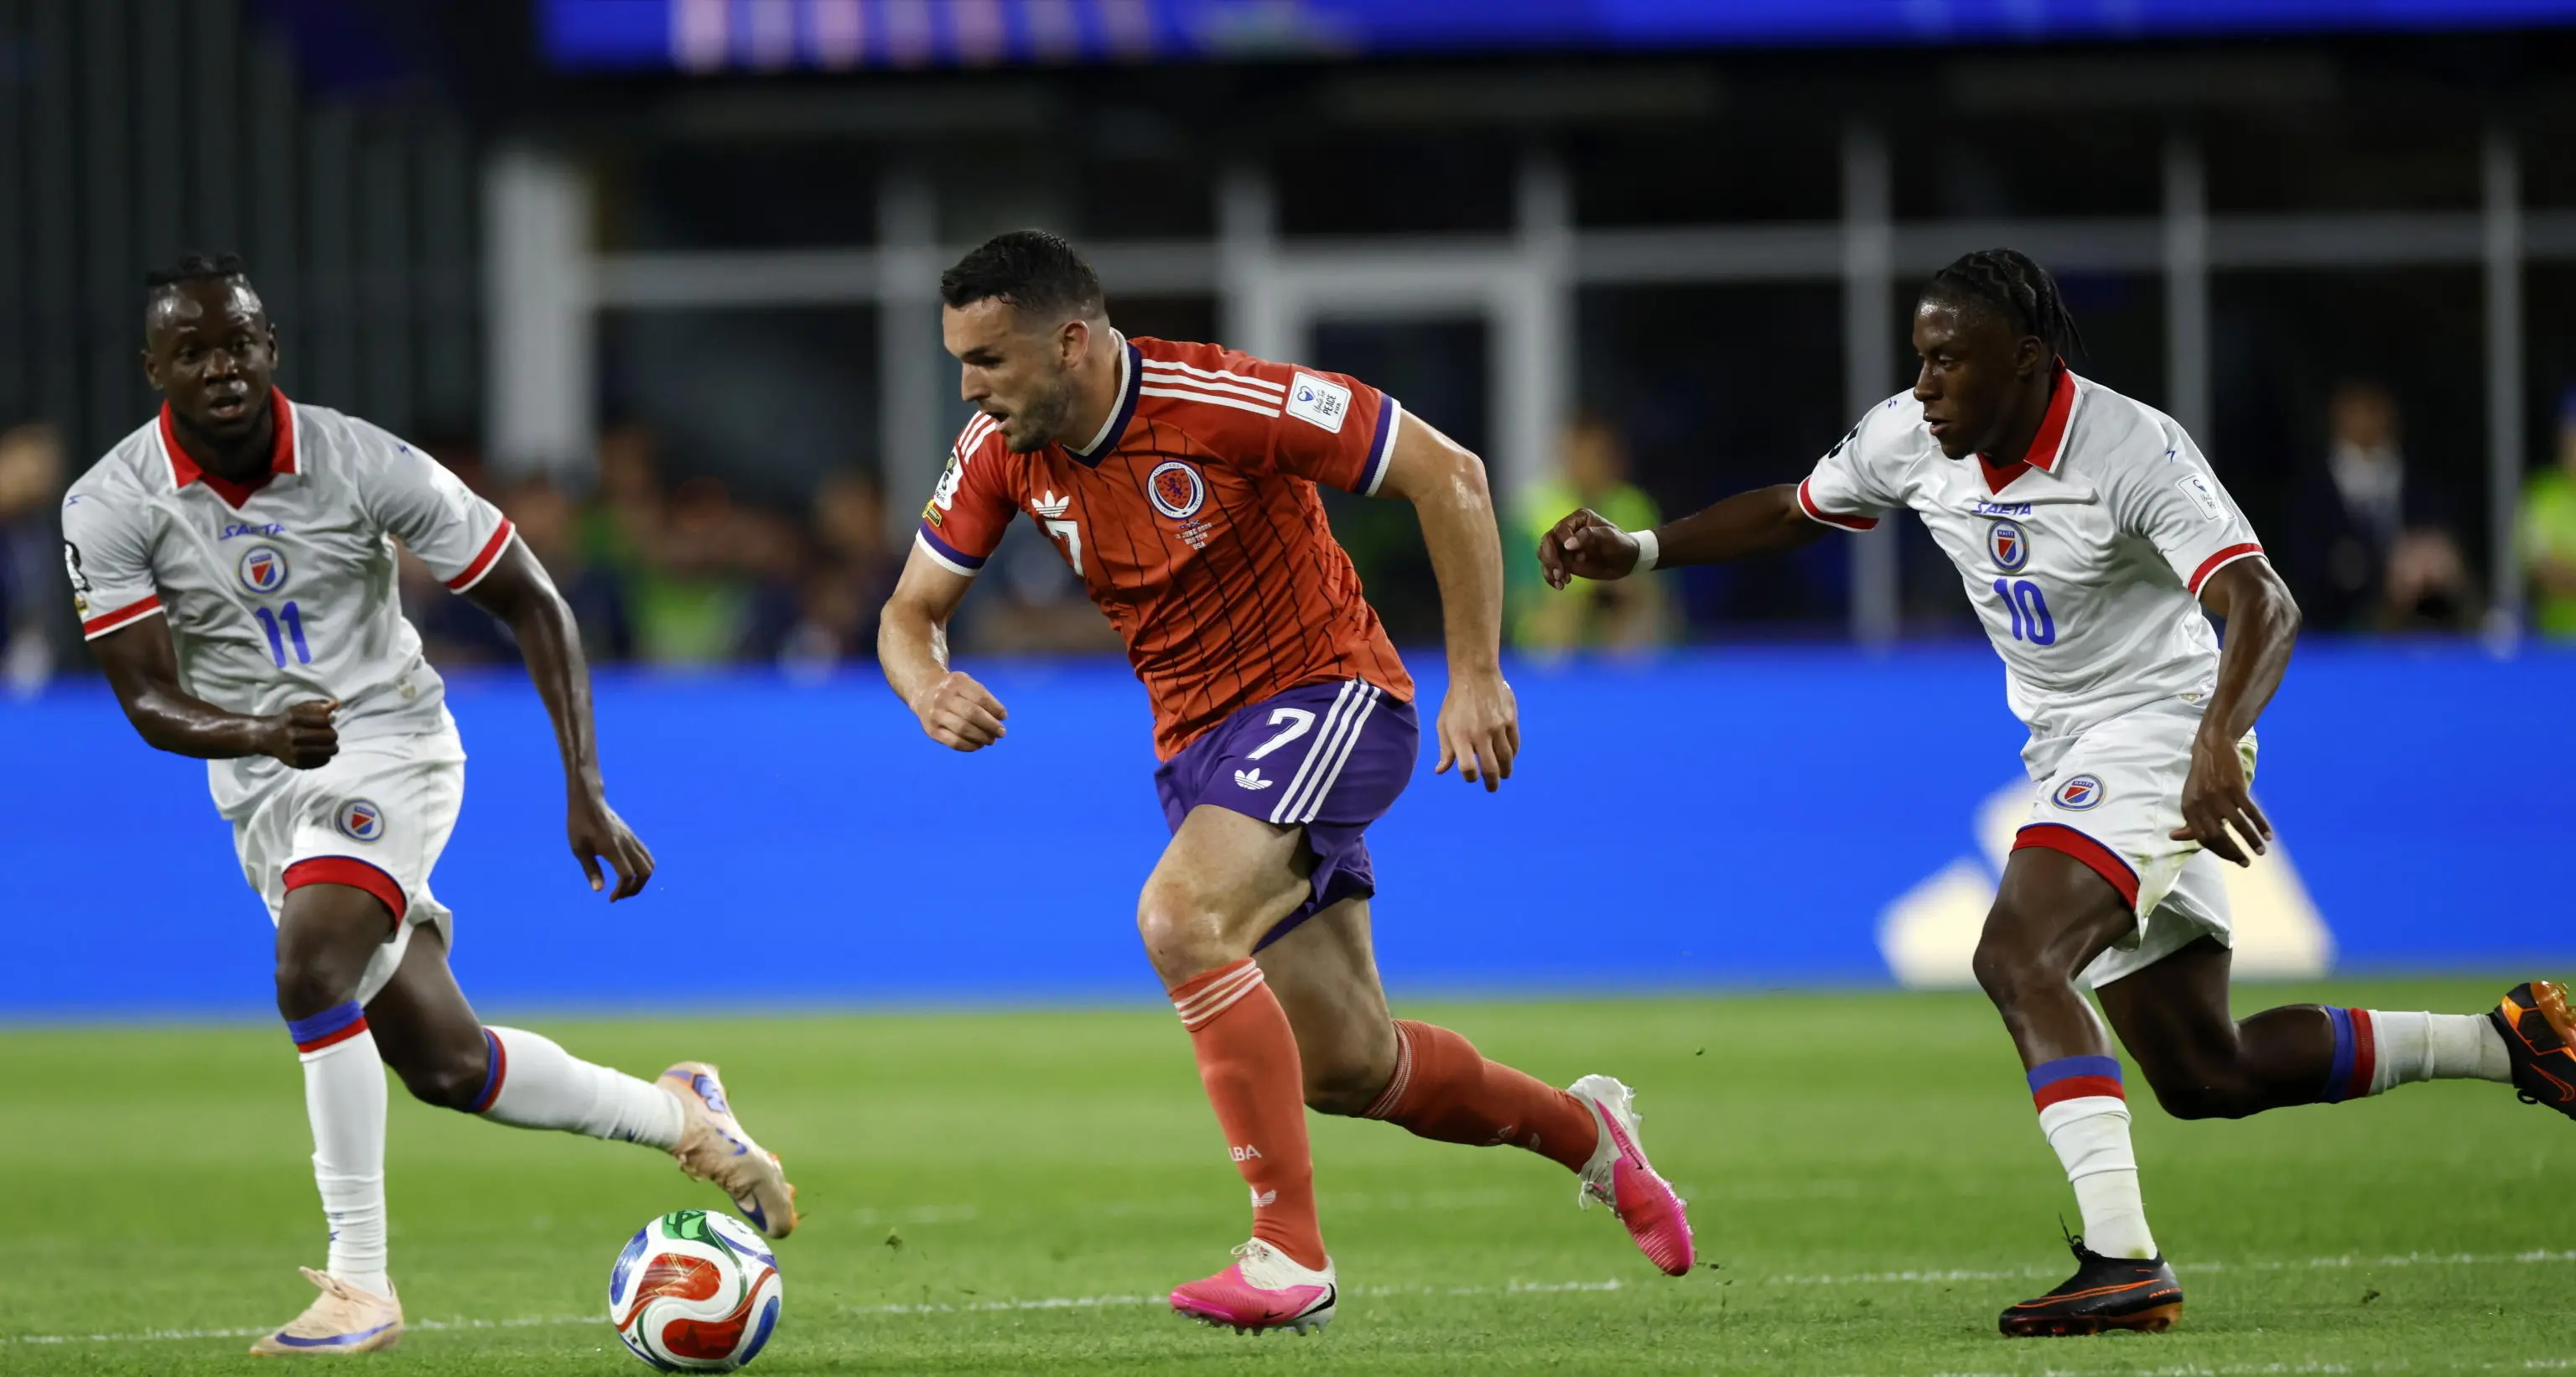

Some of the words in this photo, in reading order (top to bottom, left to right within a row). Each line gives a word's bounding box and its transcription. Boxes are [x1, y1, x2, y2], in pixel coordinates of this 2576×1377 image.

[1322, 394, 1337, 416] PEACE
[1971, 501, 2032, 516] SAETA
[1045, 520, 1084, 577] 7
[1185, 532, 1208, 545] BOSTON
[1192, 541, 1206, 550] USA
[1993, 577, 2056, 646] 10
[255, 600, 312, 668] 11
[1246, 707, 1317, 761] 7
[1228, 1144, 1262, 1161] LBA
